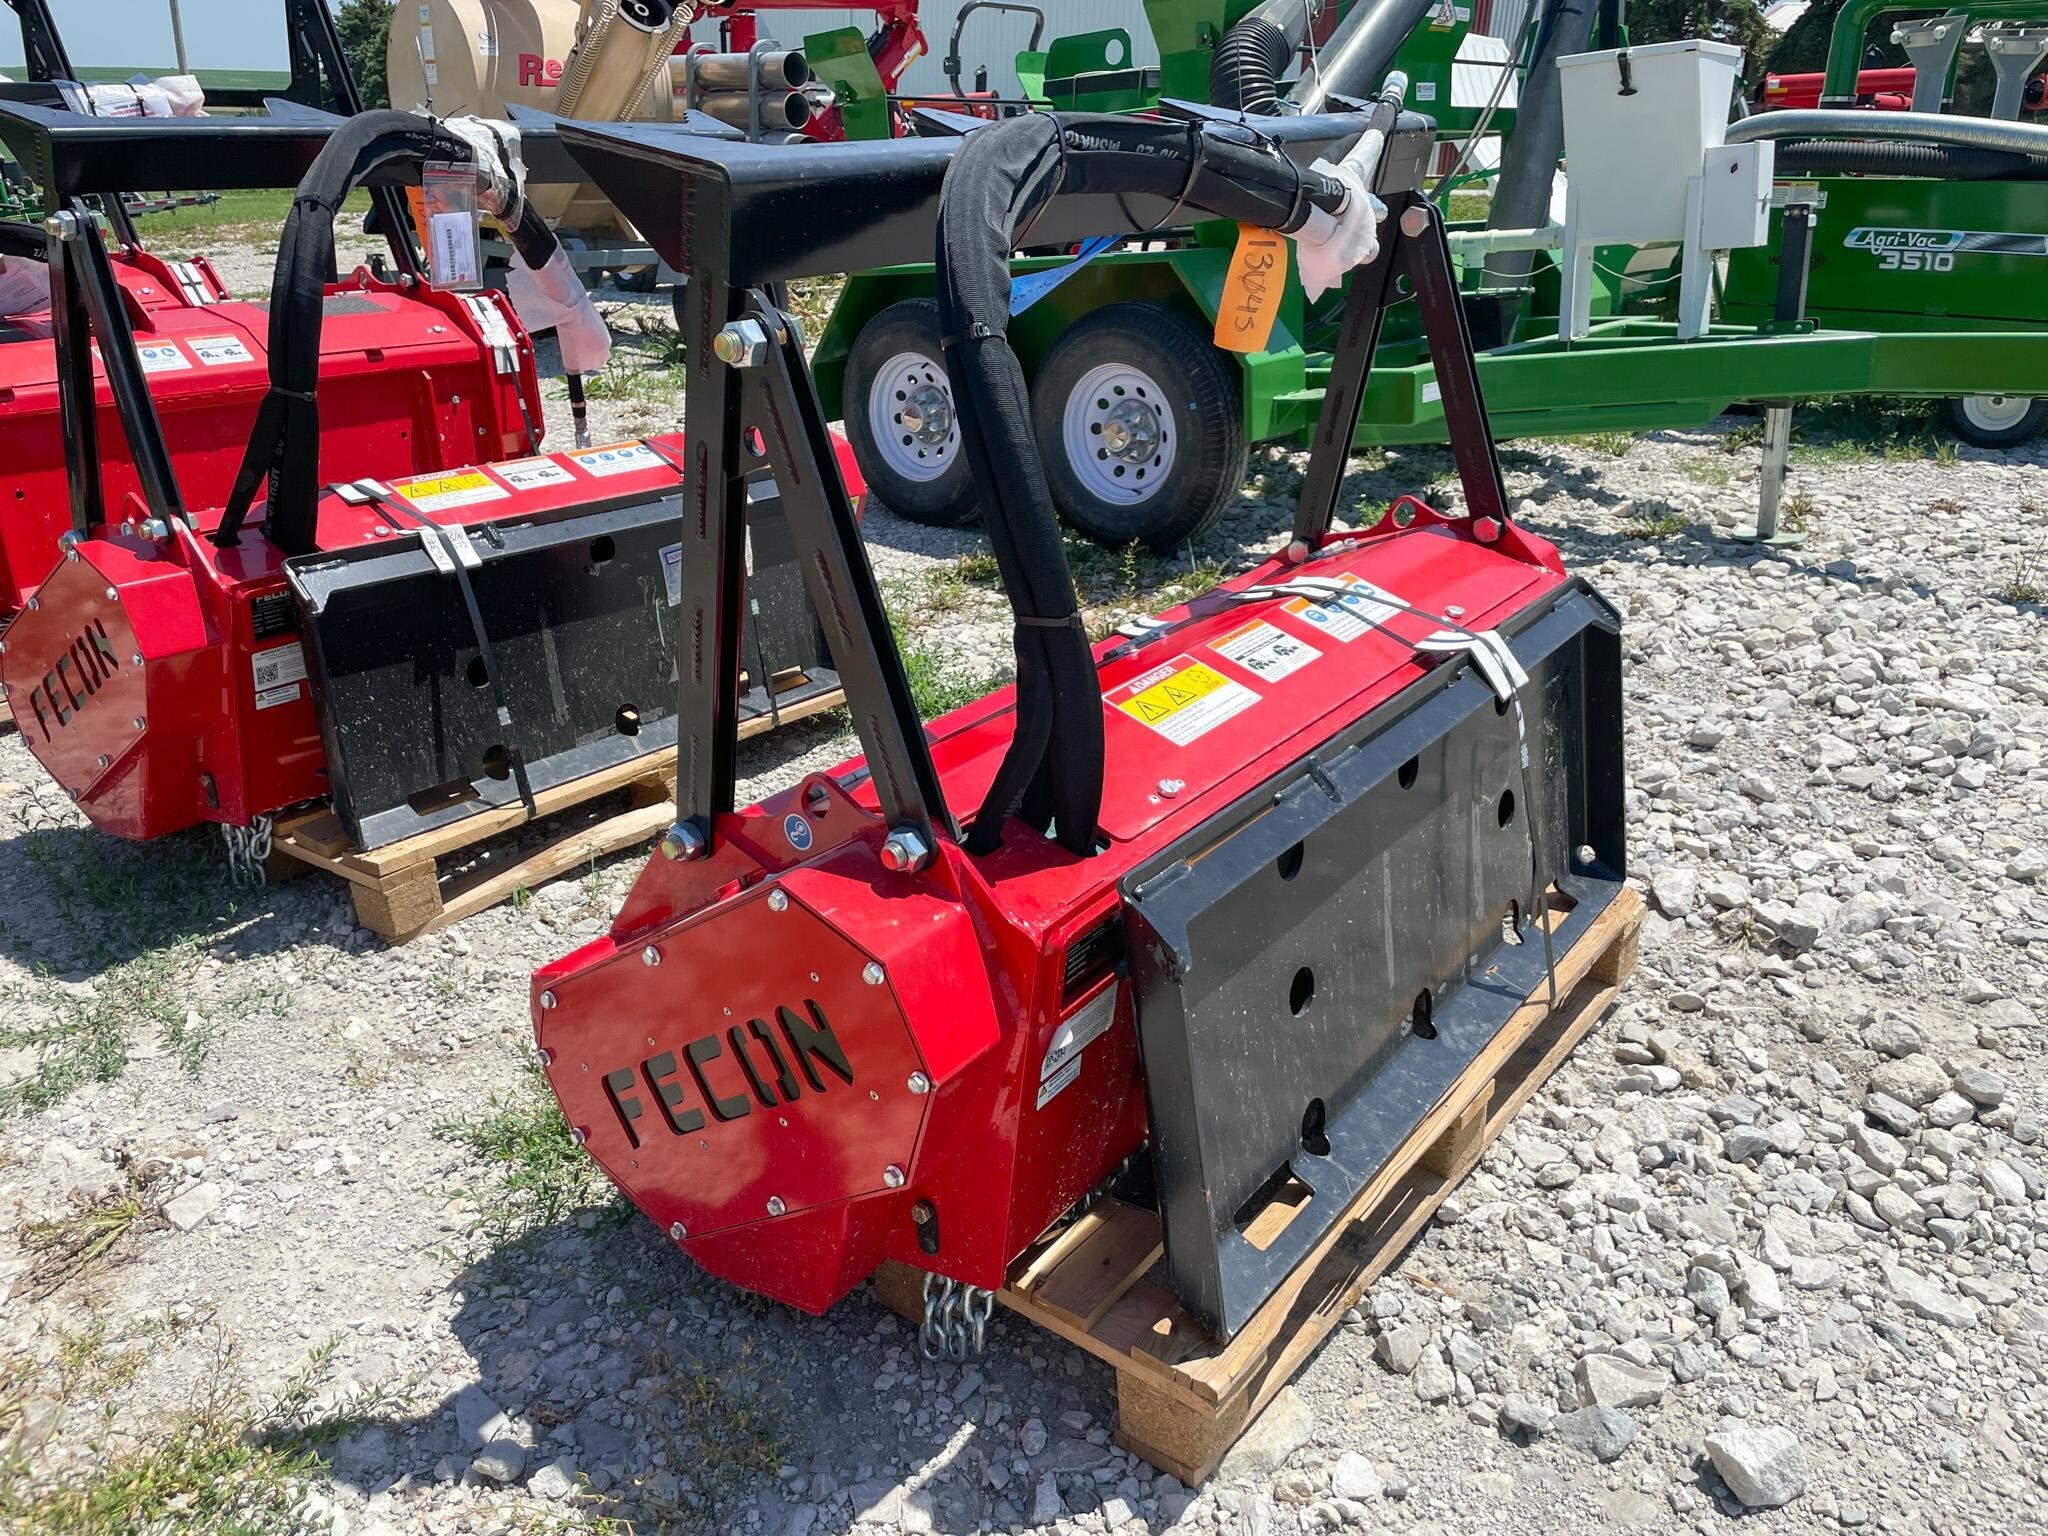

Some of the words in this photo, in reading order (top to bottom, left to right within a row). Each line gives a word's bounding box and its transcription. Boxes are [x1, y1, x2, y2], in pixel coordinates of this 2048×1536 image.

[518, 53, 566, 87] Re
[1864, 230, 1937, 255] Agri-Vac
[1878, 250, 1955, 272] 3510
[419, 470, 459, 482] DANGER
[29, 618, 119, 744] FECON
[1135, 665, 1178, 691] DANGER
[601, 998, 854, 1151] FECON
